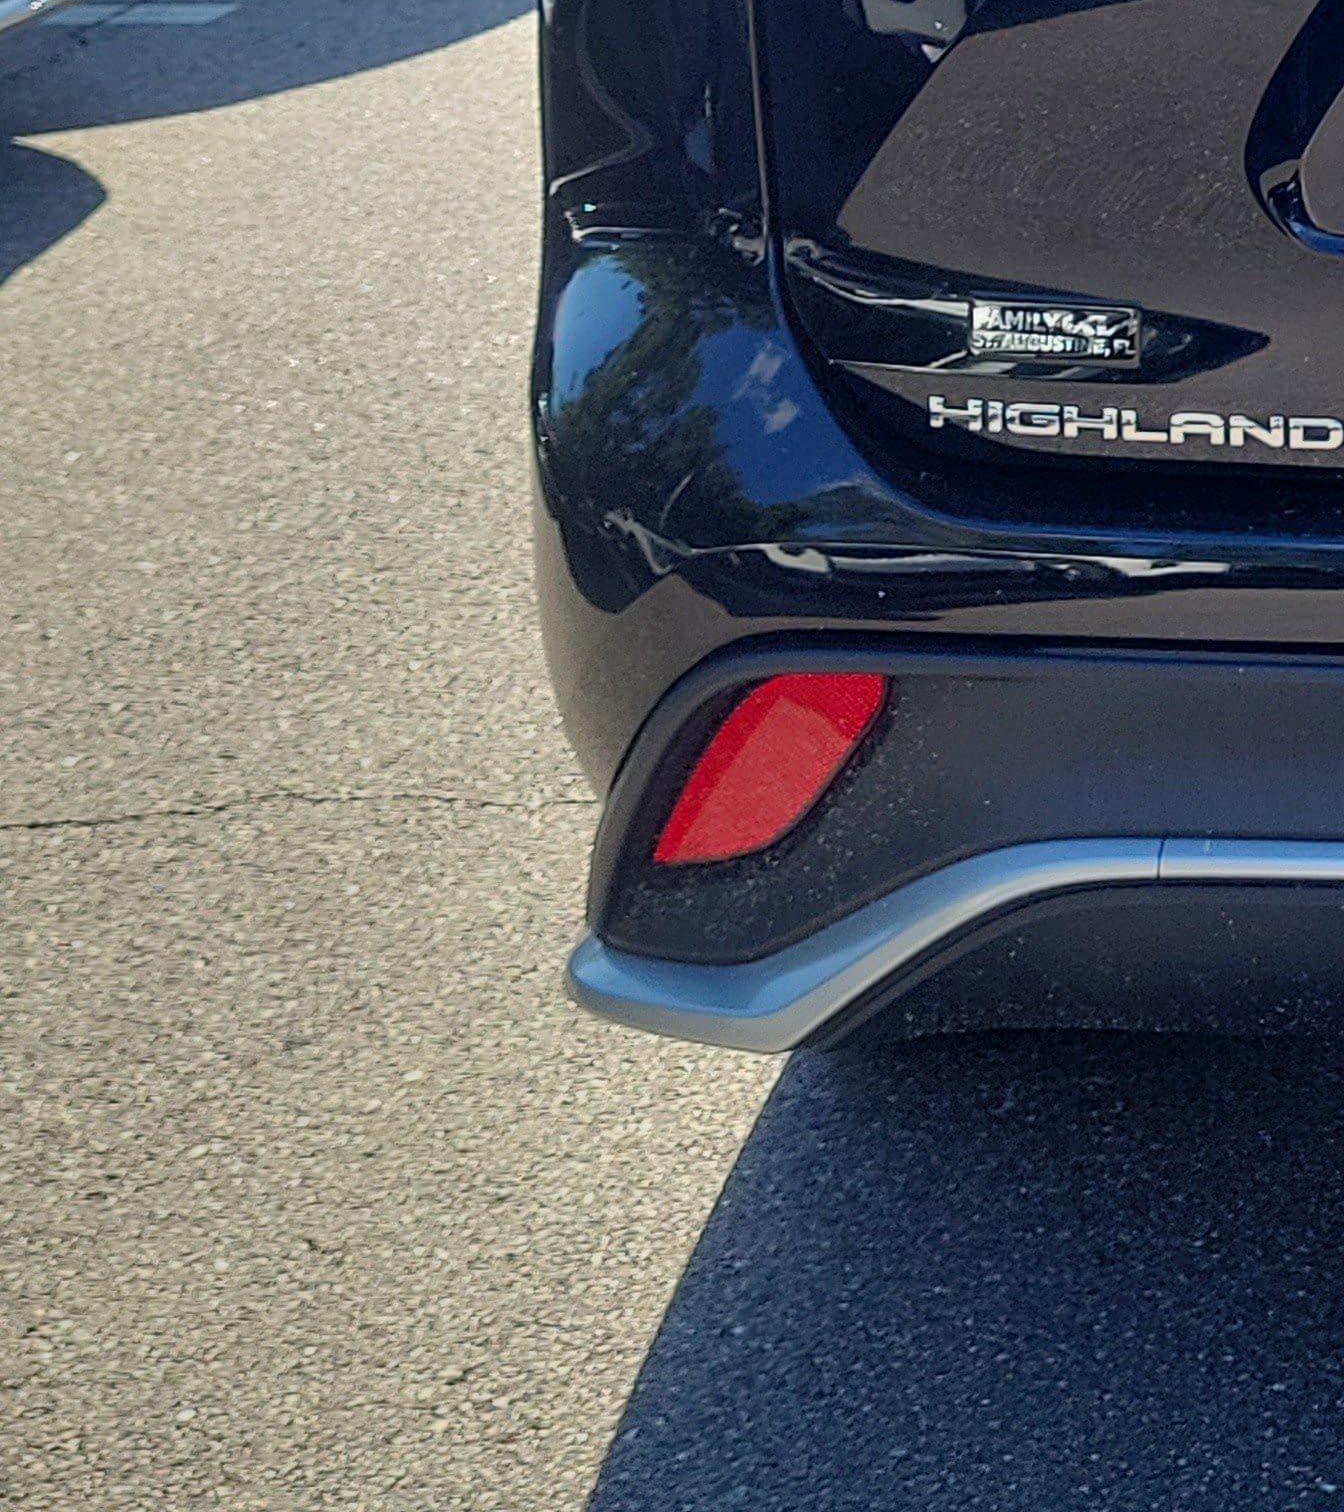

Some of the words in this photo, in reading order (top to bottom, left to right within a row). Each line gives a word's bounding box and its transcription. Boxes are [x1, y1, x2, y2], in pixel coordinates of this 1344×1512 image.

[972, 305, 1062, 333] FAMILY
[1001, 334, 1112, 358] AUGUSTINE,
[1113, 338, 1137, 356] FL
